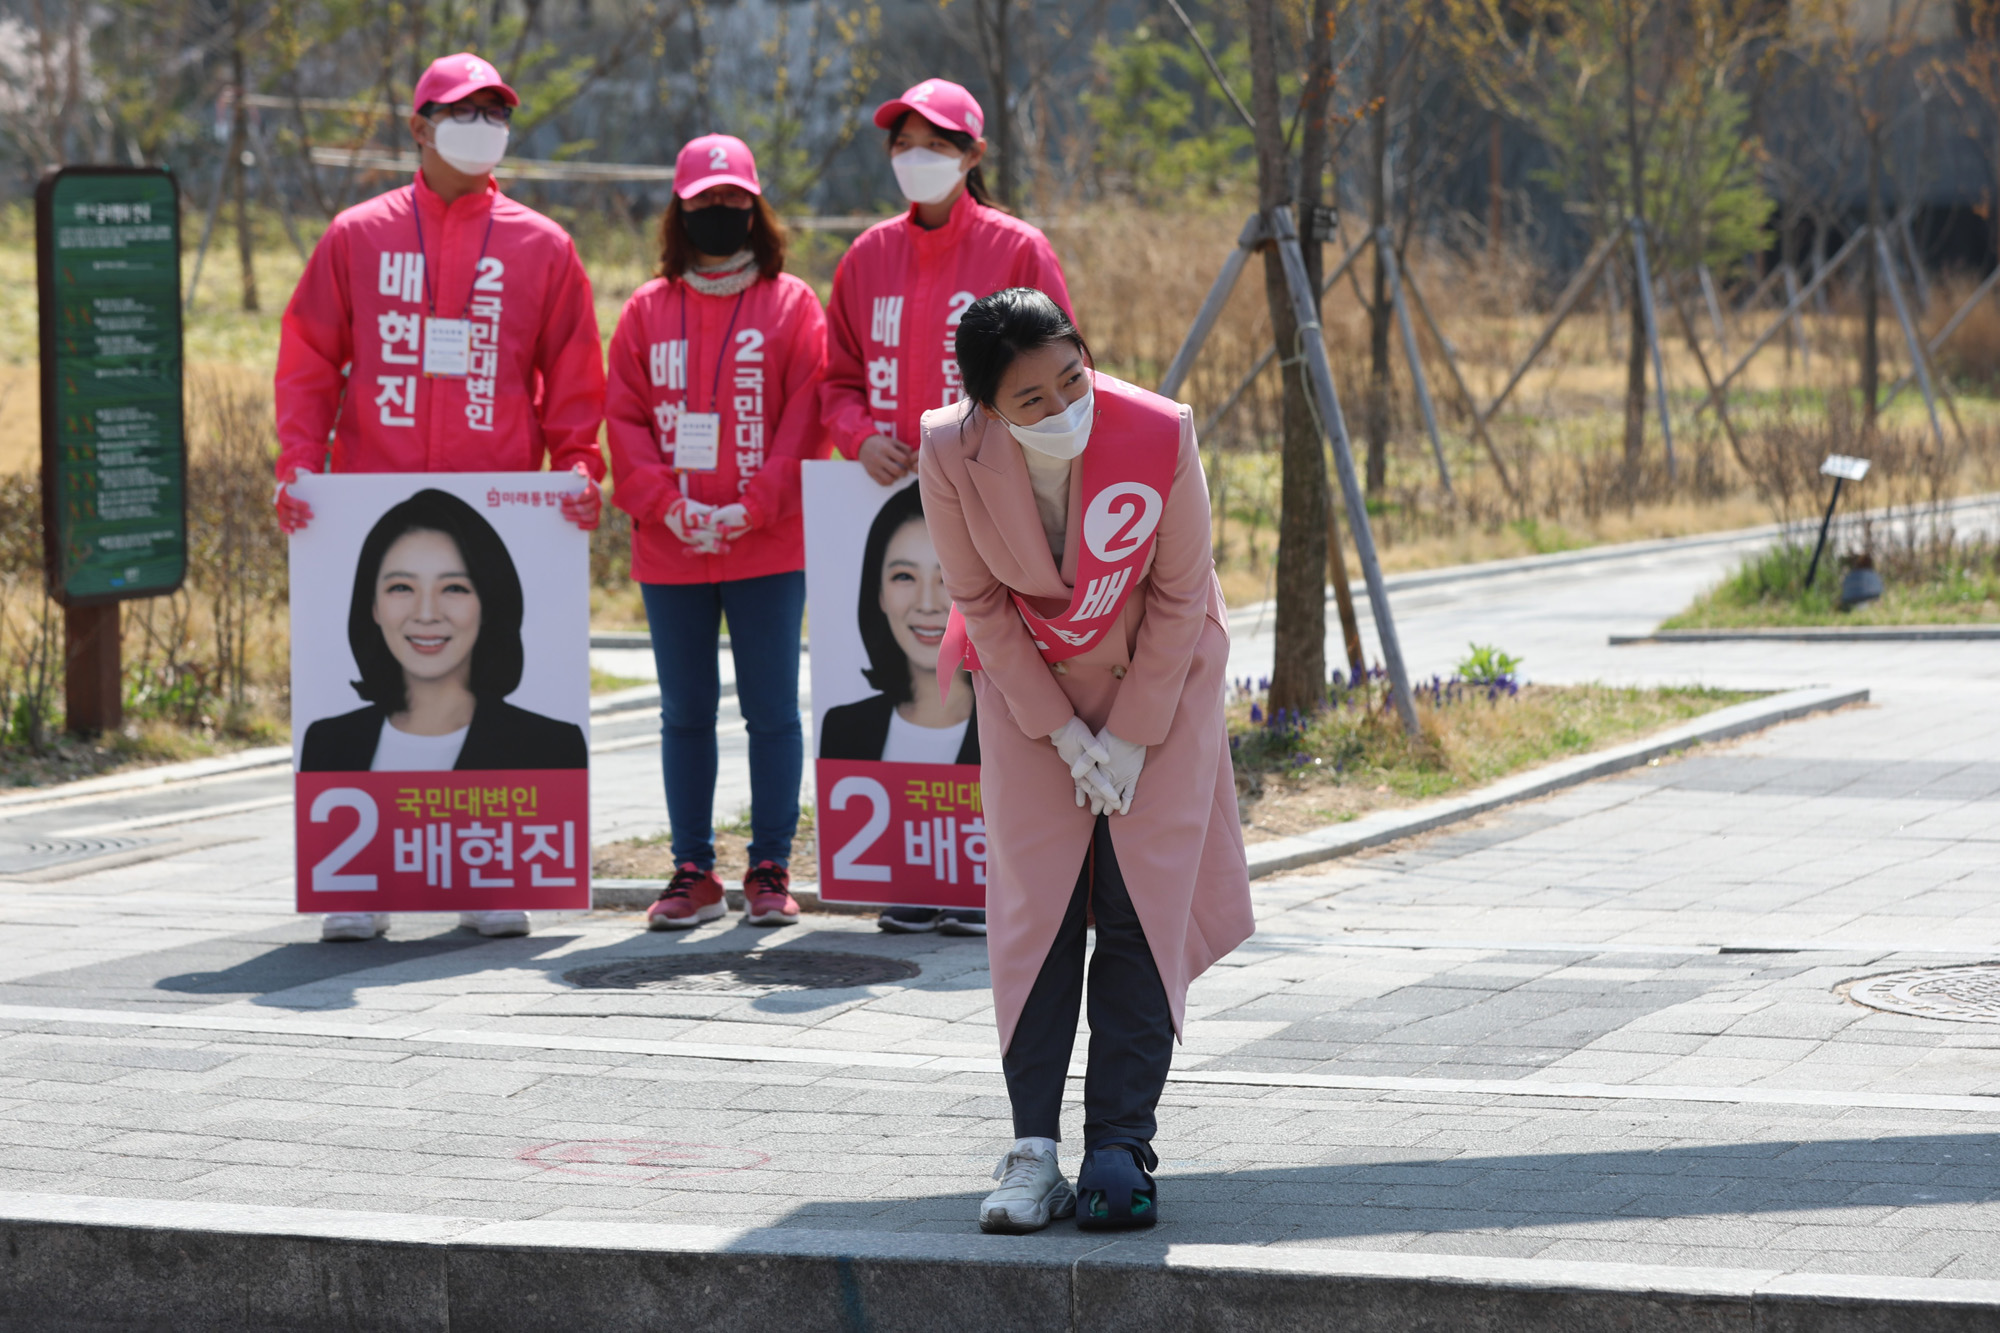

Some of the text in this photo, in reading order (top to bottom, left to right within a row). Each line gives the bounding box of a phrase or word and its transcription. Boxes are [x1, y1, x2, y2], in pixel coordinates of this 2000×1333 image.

[465, 60, 486, 81] 2
[912, 83, 934, 103] 2
[709, 147, 729, 170] 2
[946, 291, 977, 325] 2
[375, 251, 424, 427] 배현진
[465, 257, 504, 431] 2 국민대변인
[735, 328, 764, 361] 2
[650, 340, 689, 498] 배현
[1104, 492, 1147, 553] 2
[395, 786, 538, 818] 국민대변인
[904, 780, 983, 812] 국민대
[310, 787, 379, 892] 2
[829, 776, 892, 883] 2
[394, 820, 577, 888] 배현진
